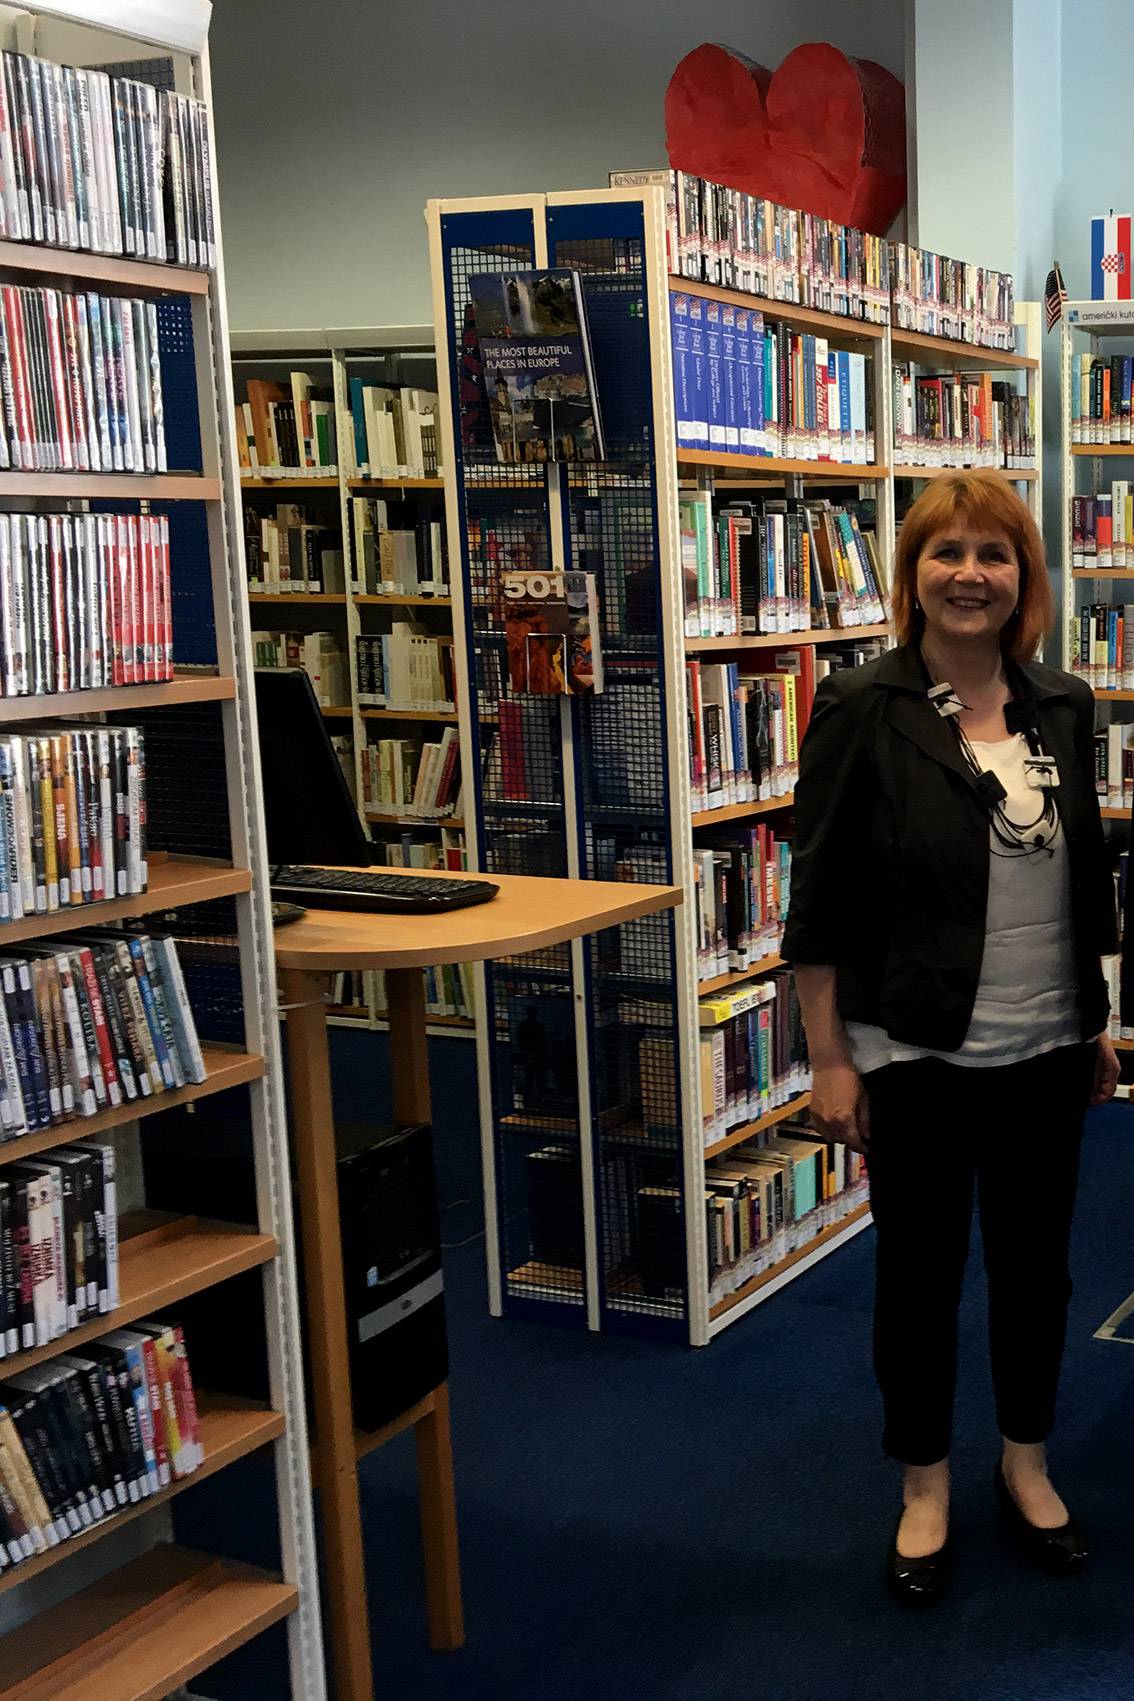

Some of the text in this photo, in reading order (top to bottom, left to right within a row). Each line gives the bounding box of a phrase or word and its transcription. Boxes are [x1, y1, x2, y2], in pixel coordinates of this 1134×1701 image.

[202, 140, 210, 190] OLYMPUS
[614, 175, 649, 187] KENNEDY
[1082, 309, 1118, 321] američki
[485, 345, 573, 358] THE MOST BEAUTIFUL
[486, 357, 560, 369] PLACES IN EUROPE
[816, 386, 824, 423] COLLEG
[894, 370, 903, 429] DAN BROWN
[503, 575, 567, 599] 501
[711, 734, 719, 769] WHISK
